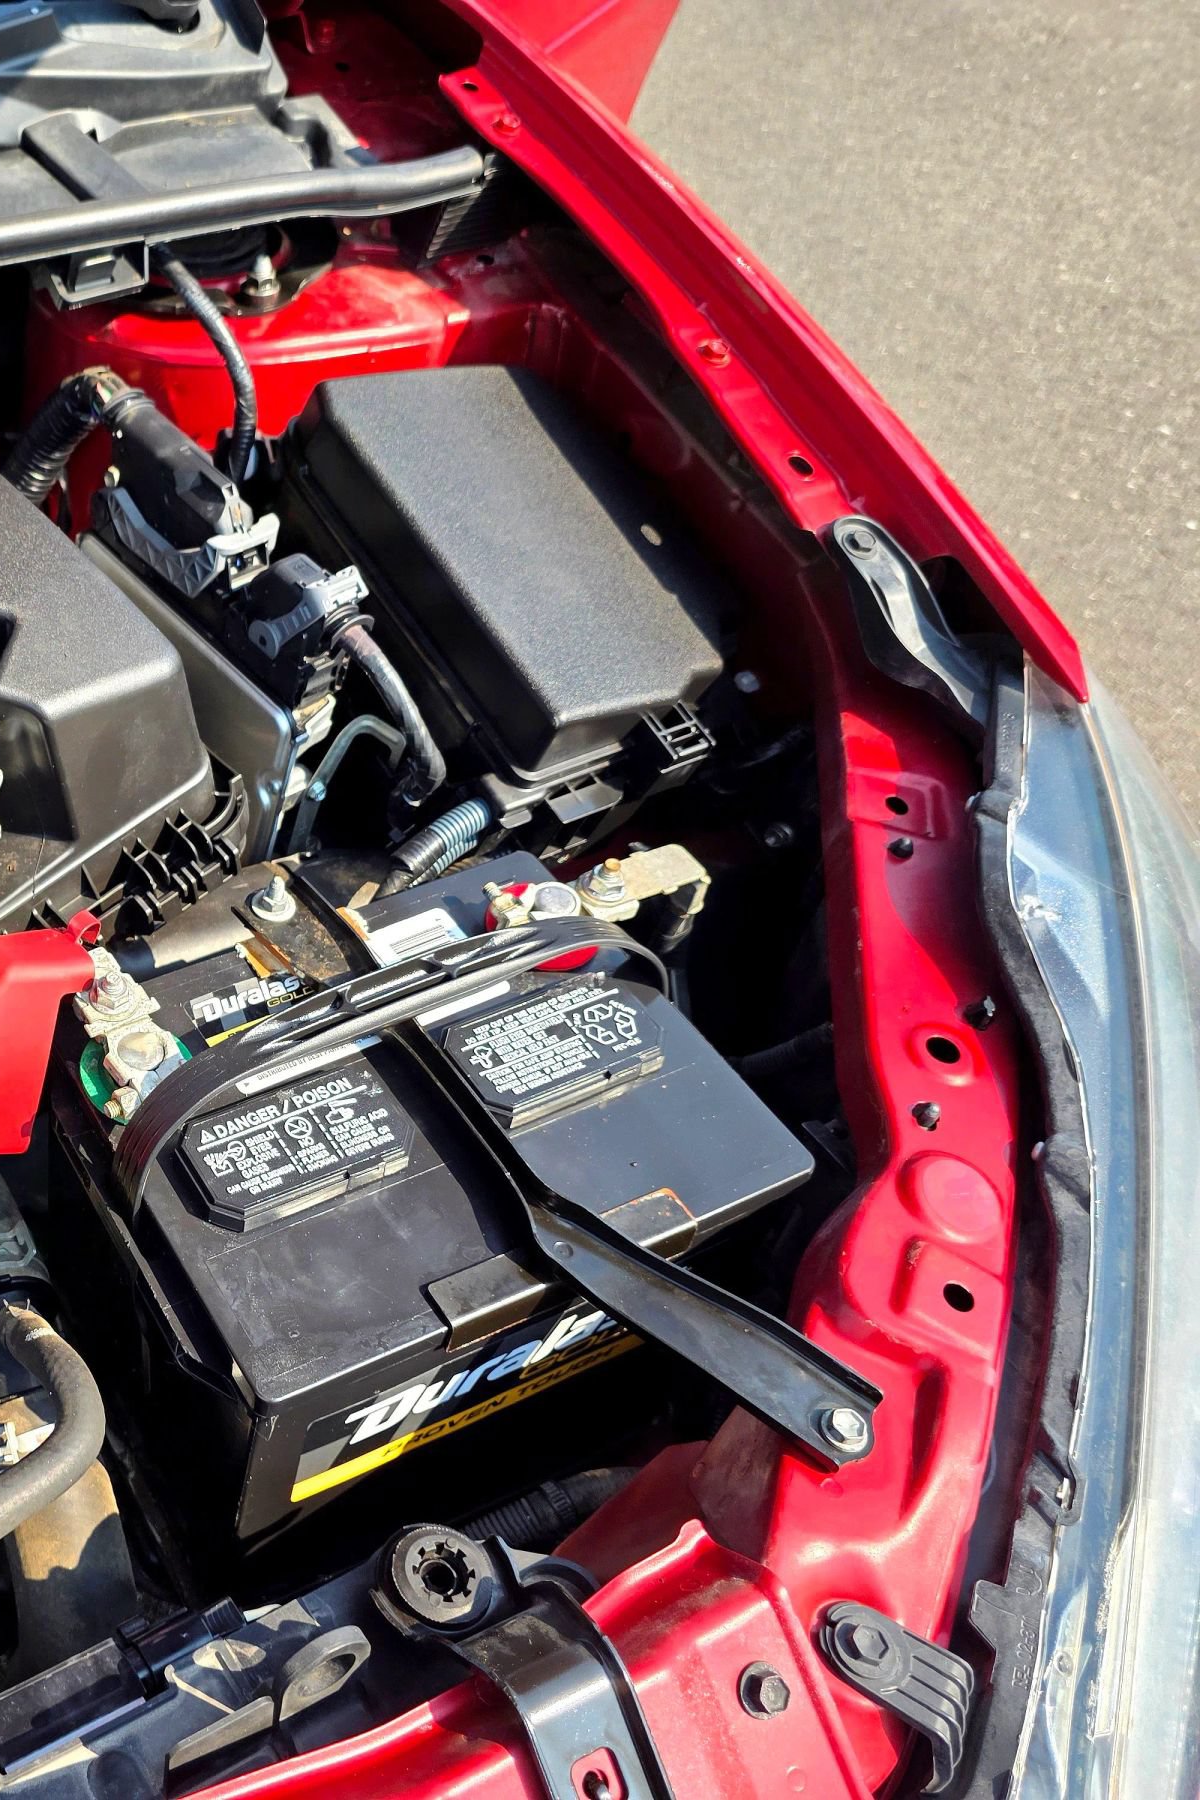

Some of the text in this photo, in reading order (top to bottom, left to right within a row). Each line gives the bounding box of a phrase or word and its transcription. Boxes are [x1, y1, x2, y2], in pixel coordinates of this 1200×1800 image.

[192, 976, 300, 1022] Duralas
[213, 1105, 281, 1139] DANGER
[291, 1077, 352, 1108] POISON
[329, 1108, 388, 1135] SULFURIC ACID
[335, 1123, 374, 1142] CAN CAUSE
[244, 1130, 275, 1147] SHIELD
[249, 1140, 272, 1155] EYES
[298, 1136, 315, 1148] NO
[236, 1147, 281, 1171] EXPLOSIVE
[241, 1162, 270, 1179] GASES
[519, 1327, 624, 1379] GOL
[344, 1310, 618, 1445] Durala
[381, 1394, 507, 1457] PROVEN
